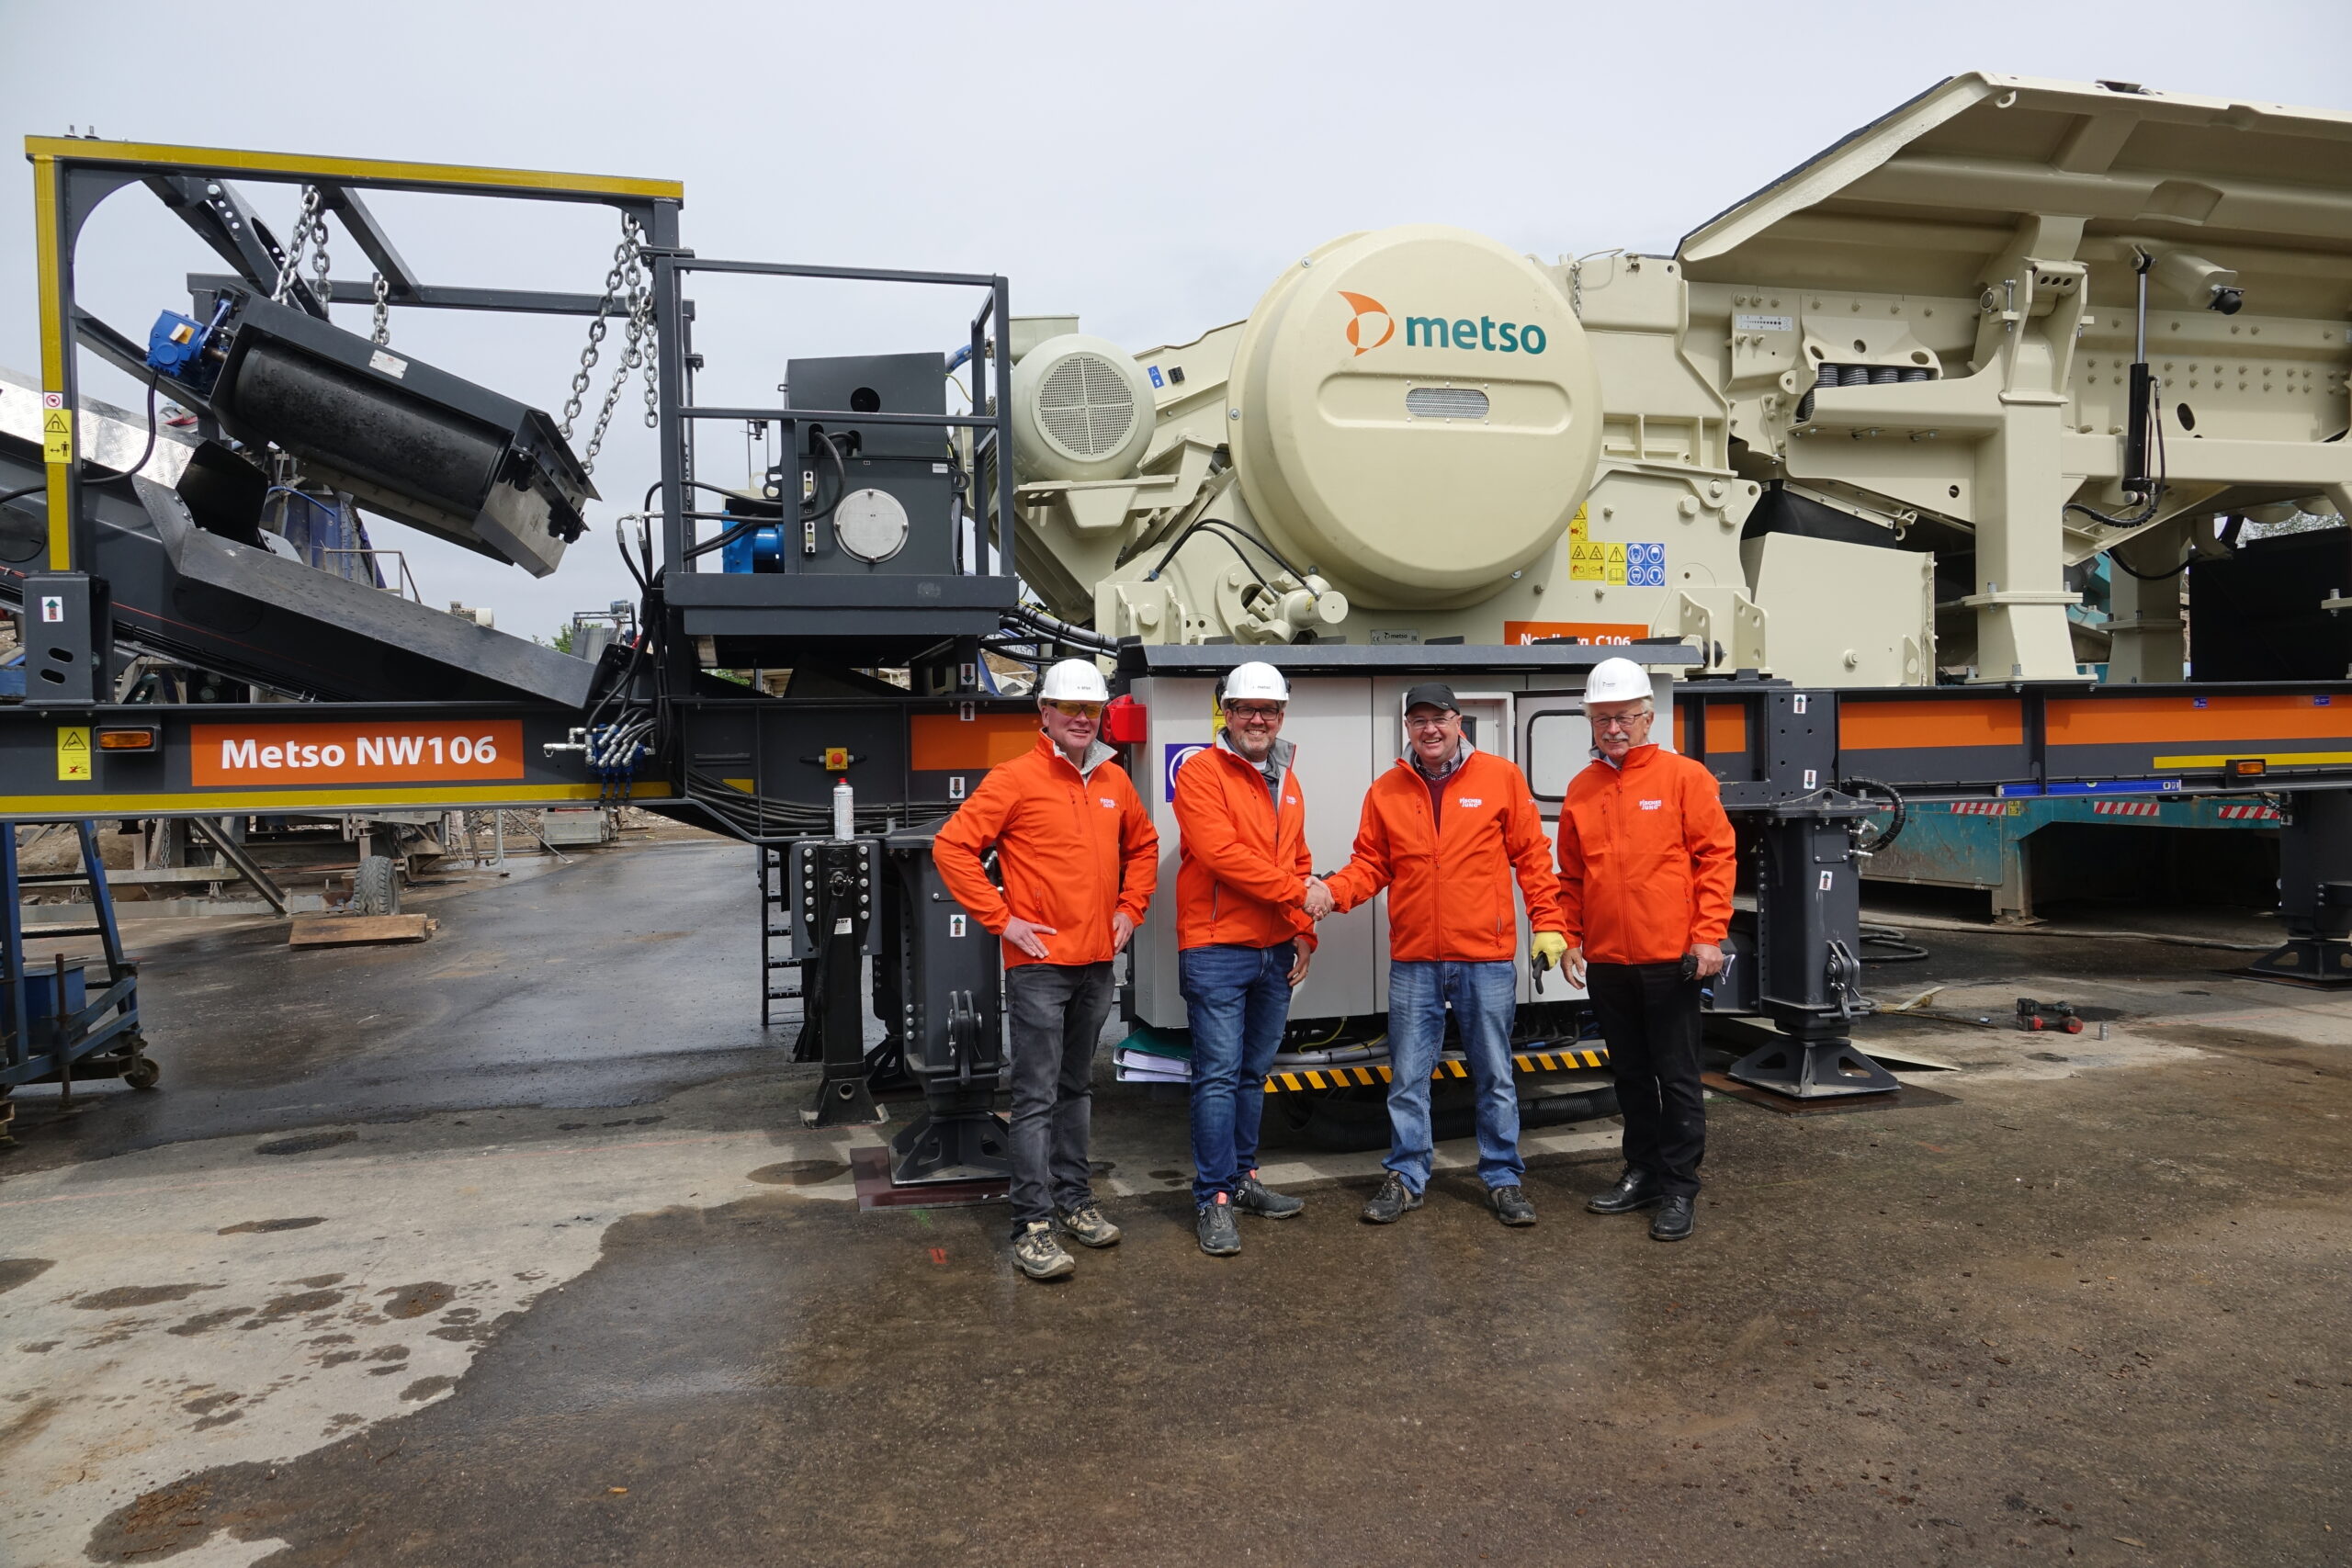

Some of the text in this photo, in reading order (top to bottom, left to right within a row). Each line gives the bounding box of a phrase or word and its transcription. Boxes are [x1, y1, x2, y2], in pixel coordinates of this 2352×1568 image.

[1406, 315, 1547, 355] metso
[1595, 635, 1632, 646] C106
[221, 735, 497, 770] Metso NW106
